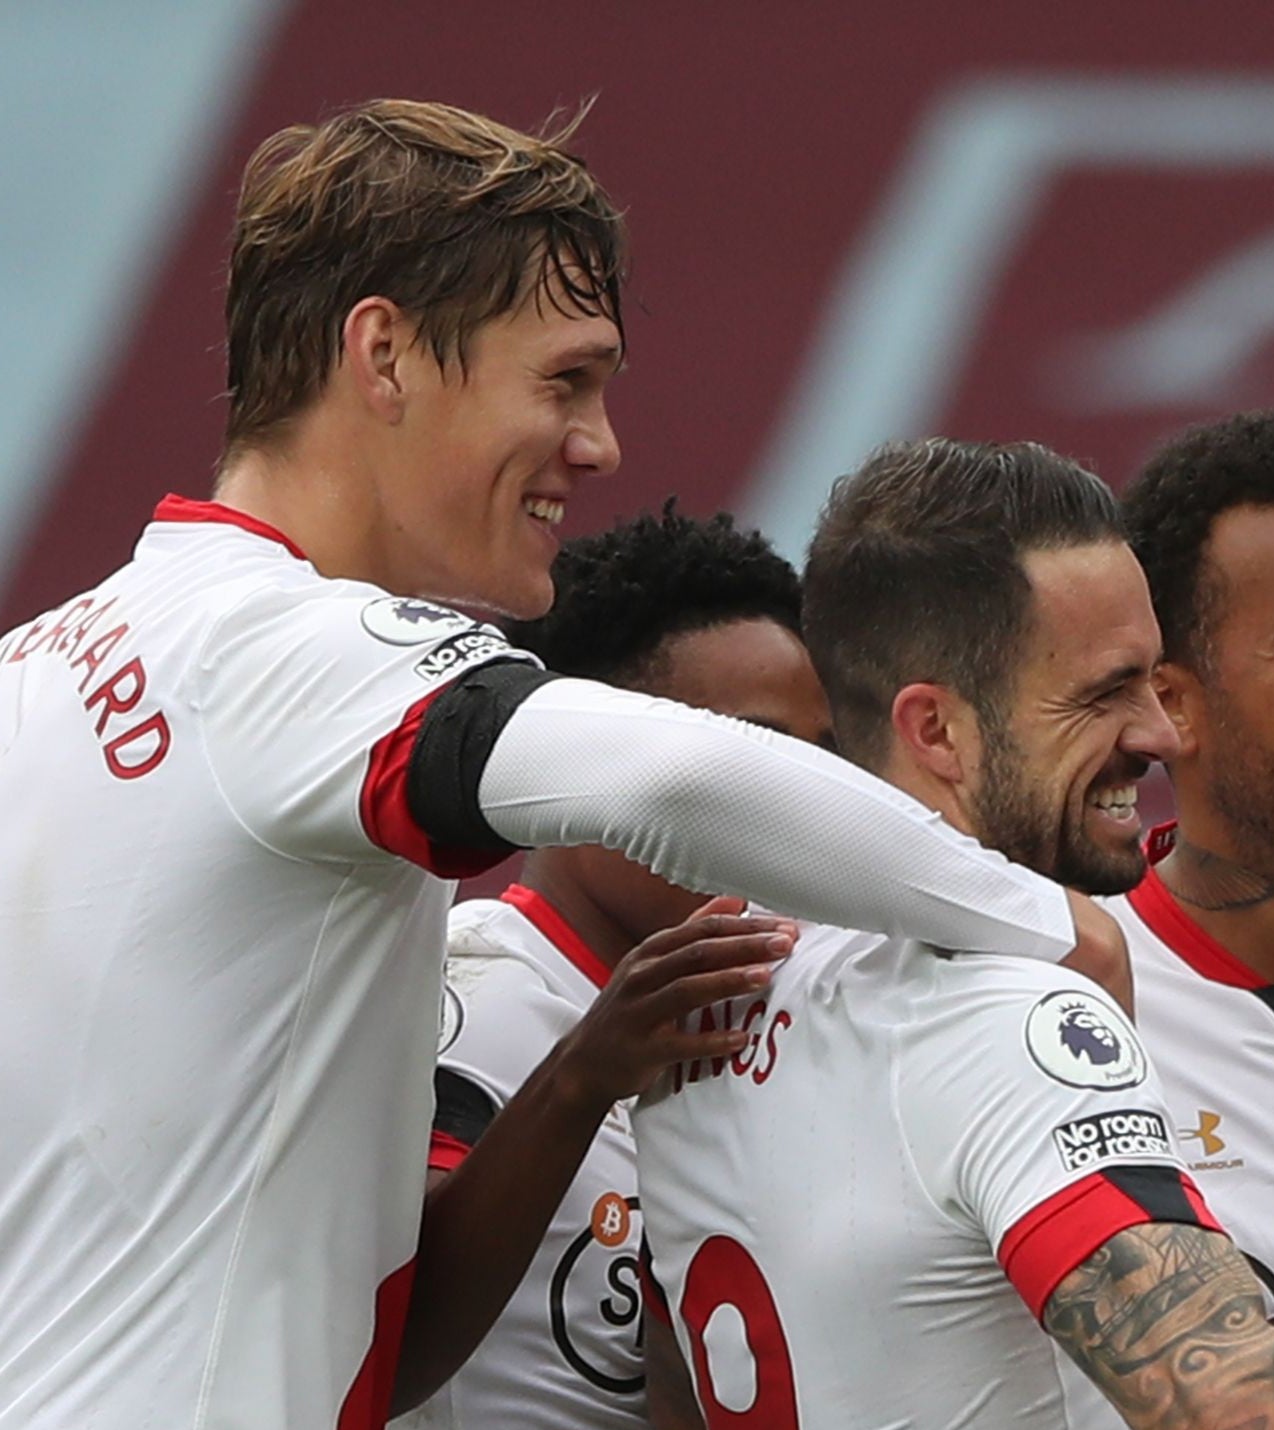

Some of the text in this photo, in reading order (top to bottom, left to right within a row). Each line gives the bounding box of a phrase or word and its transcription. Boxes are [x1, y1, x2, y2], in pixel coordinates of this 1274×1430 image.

[1056, 1113, 1163, 1149] No room
[1061, 1143, 1102, 1171] for
